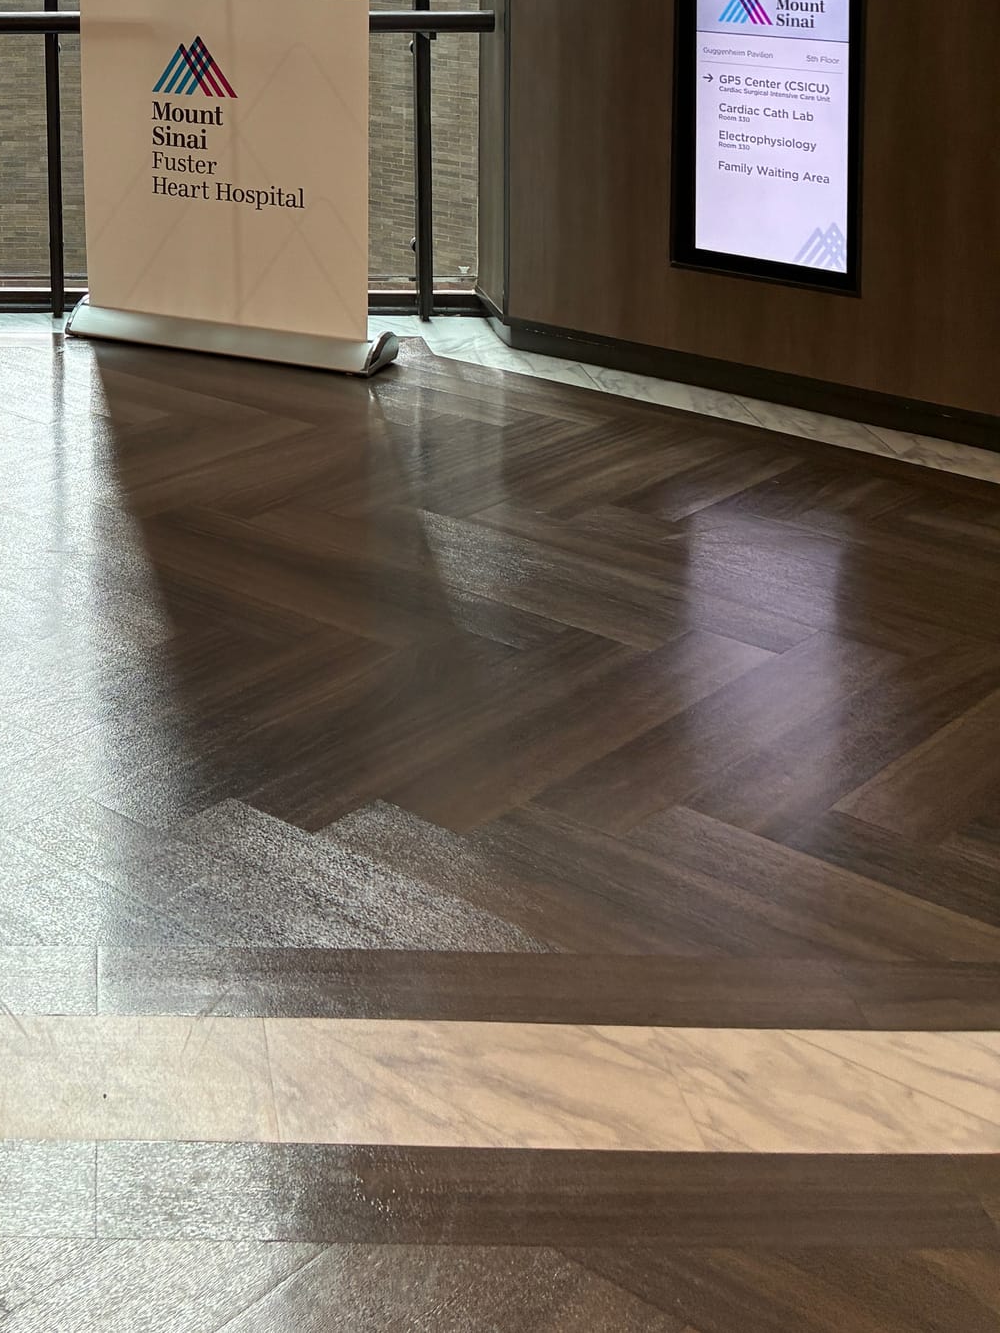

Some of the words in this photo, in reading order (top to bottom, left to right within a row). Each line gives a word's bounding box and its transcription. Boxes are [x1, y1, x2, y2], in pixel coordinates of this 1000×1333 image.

[776, 14, 815, 28] Sinai
[744, 77, 781, 89] Center
[784, 80, 830, 95] (CSICU)
[151, 101, 224, 126] Mount
[719, 103, 760, 116] Cardiac
[763, 107, 789, 119] Cath
[793, 110, 814, 122] Lab
[152, 126, 208, 150] Sinai
[719, 129, 816, 152] Electrophysiology
[152, 151, 217, 175] Fuster
[718, 160, 753, 176] Family
[756, 165, 799, 182] Waiting
[802, 171, 830, 184] Area
[152, 176, 210, 200] Heart
[215, 182, 305, 210] Hospital
